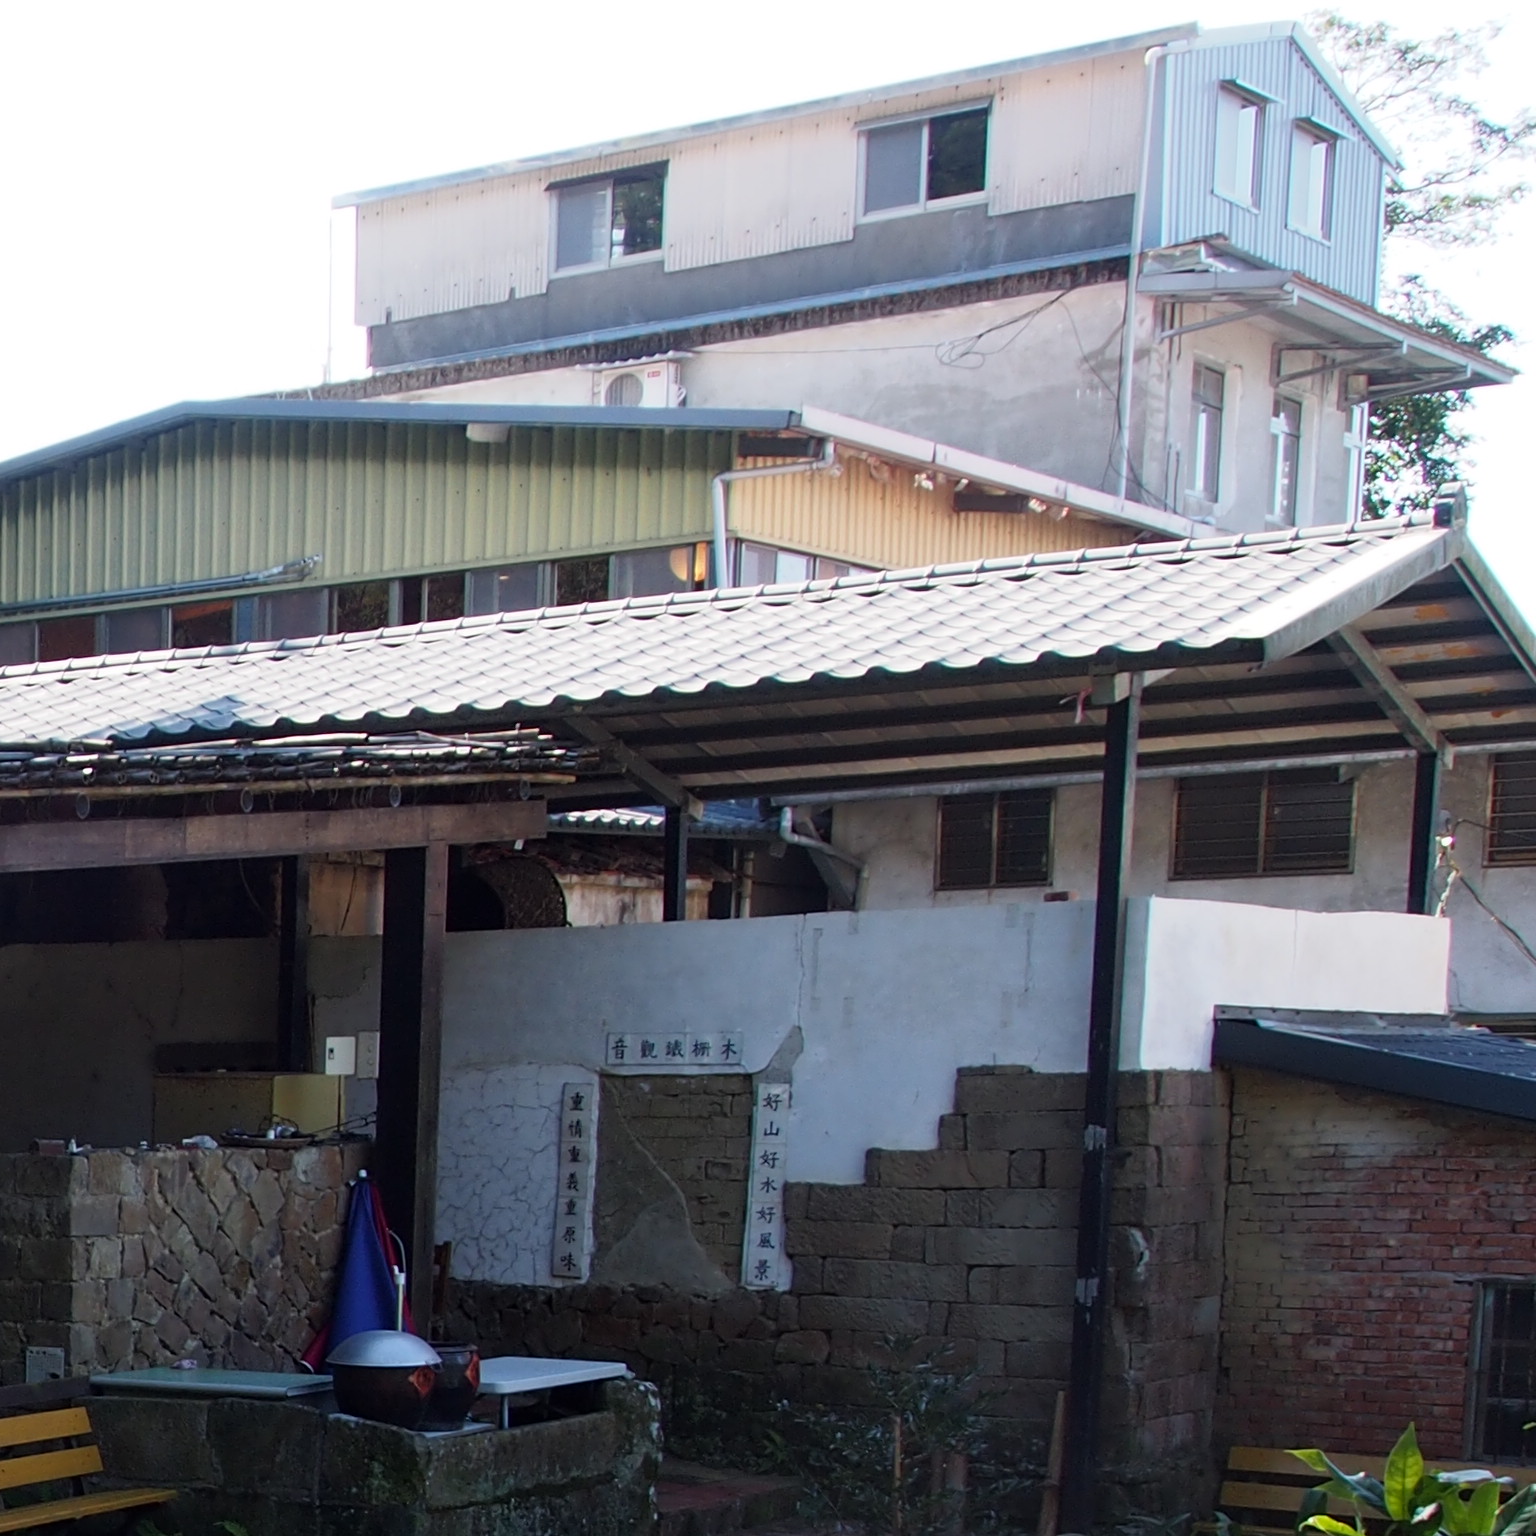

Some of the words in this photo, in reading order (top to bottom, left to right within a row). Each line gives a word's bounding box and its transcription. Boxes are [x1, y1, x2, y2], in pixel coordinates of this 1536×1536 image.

[753, 1092, 783, 1281] 好山好水好風景
